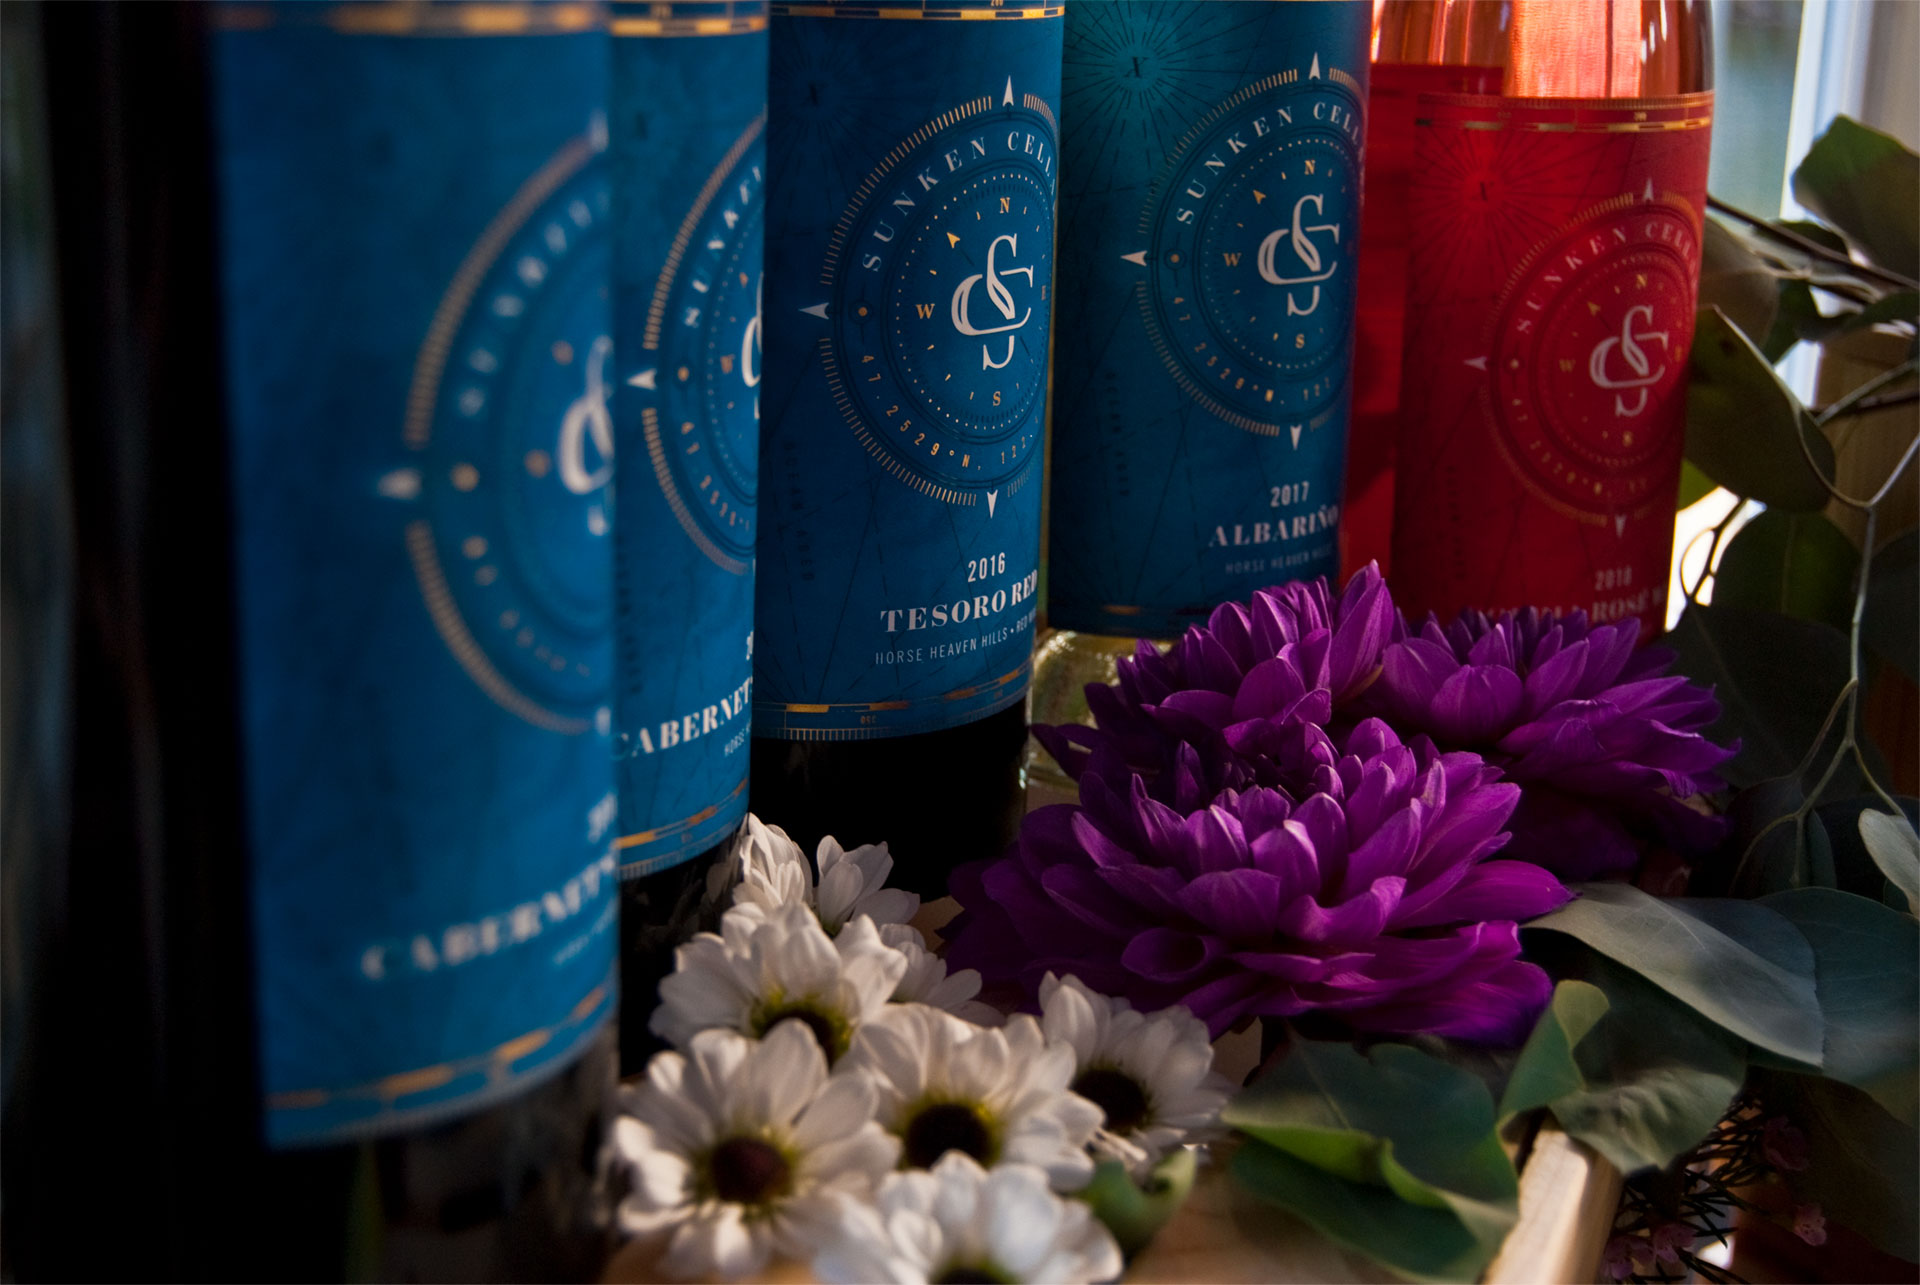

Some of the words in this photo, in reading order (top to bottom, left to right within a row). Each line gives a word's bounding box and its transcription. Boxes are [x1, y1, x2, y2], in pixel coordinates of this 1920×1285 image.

[1176, 106, 1293, 224] SUNKEN
[862, 137, 987, 272] SUNKEN
[1000, 197, 1011, 213] N
[916, 303, 935, 319] W
[992, 390, 1003, 407] S
[1270, 480, 1310, 508] 2017
[967, 552, 1006, 583] 2016
[880, 589, 1007, 633] TESORO
[875, 648, 923, 665] HORSE
[929, 637, 977, 660] HEAVEN
[981, 626, 1008, 648] HILLS
